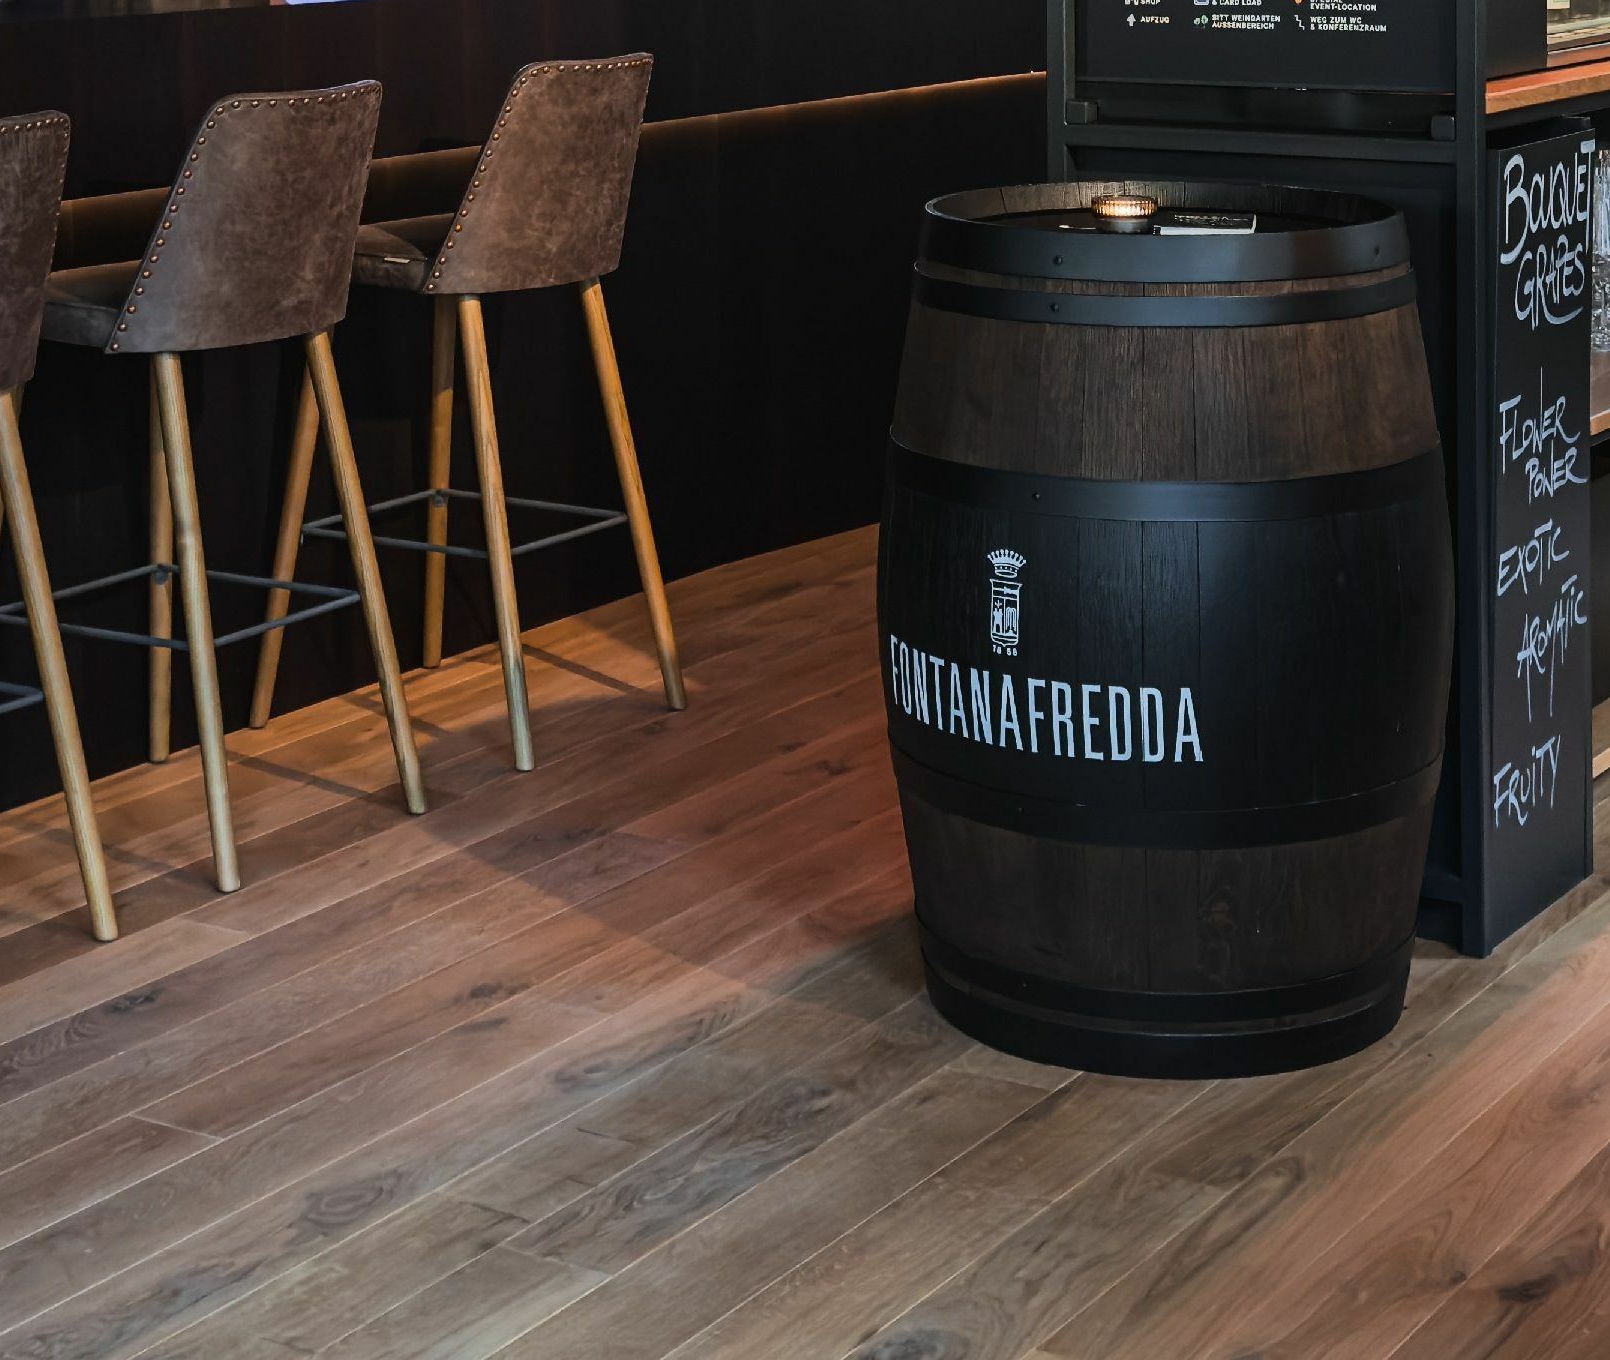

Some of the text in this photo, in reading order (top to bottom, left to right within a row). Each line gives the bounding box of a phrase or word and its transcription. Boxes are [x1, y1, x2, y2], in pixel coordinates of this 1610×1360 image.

[1140, 15, 1170, 24] AUFZUG
[1211, 22, 1275, 30] AUSSENBEREICH
[1231, 14, 1281, 23] WEINGARTEN
[1310, 3, 1377, 12] EVENT-LOCATION
[1317, 24, 1387, 33] KONFERENZRAUM
[1329, 16, 1347, 24] ZUM
[1349, 16, 1363, 24] WC
[1500, 139, 1596, 265] BOUQUET
[1514, 234, 1585, 331] GRAPES
[1499, 367, 1581, 474] FLOWER
[1525, 439, 1588, 504] POWER
[1496, 518, 1570, 596] EXOTIC
[1516, 574, 1587, 723] AROMATIC
[889, 633, 1204, 762] FONTANAFREDDA
[1493, 733, 1562, 828] FRUITY
